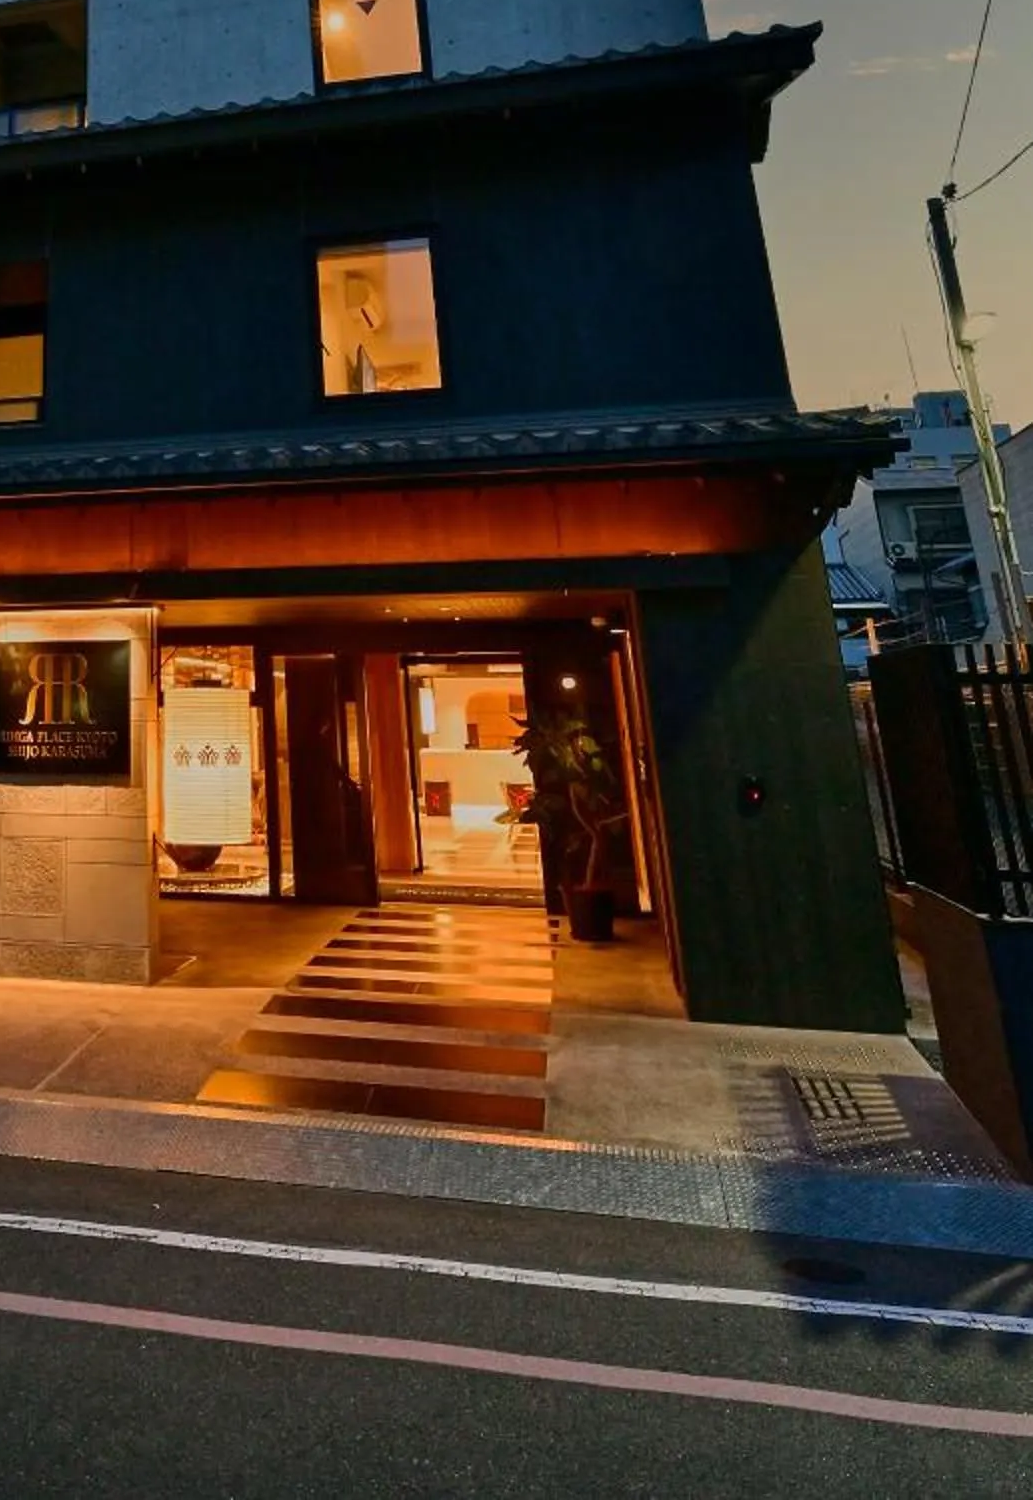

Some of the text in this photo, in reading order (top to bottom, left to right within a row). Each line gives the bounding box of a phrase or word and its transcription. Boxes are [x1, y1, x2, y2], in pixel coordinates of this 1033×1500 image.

[37, 730, 73, 743] PLACE
[75, 730, 117, 744] KYOTO
[7, 744, 40, 760] SHIJO
